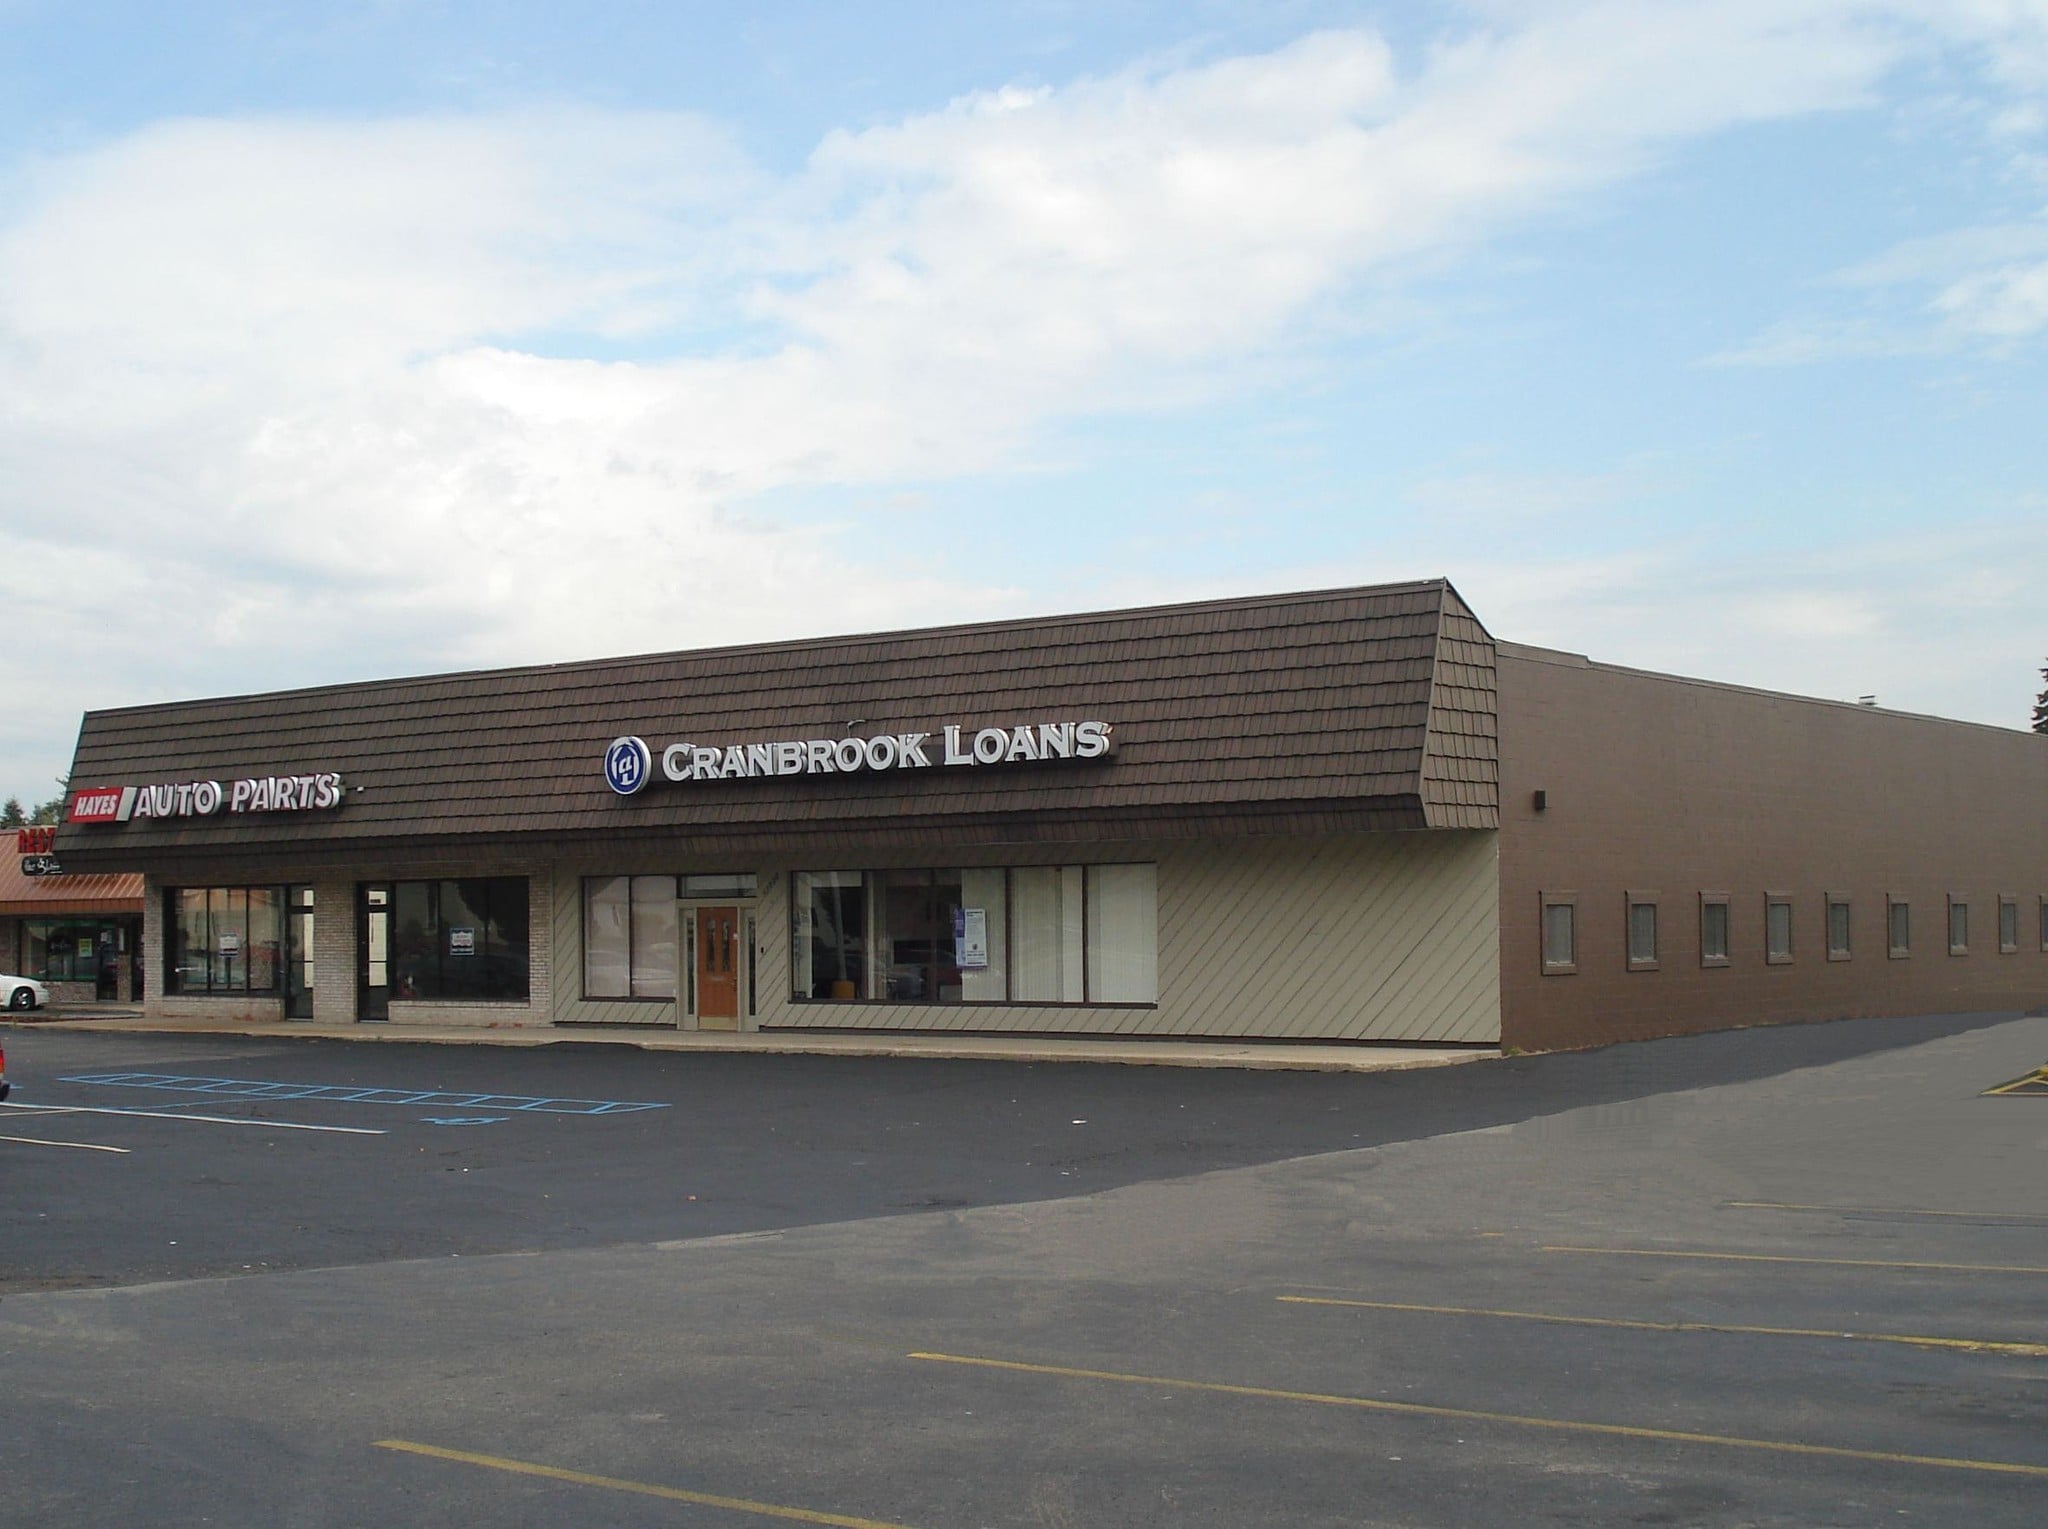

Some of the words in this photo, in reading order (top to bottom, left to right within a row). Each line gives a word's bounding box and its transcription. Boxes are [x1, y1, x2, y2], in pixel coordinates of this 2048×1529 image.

[663, 733, 931, 782] CRANBROOK
[944, 721, 1112, 766] LOANS
[74, 794, 118, 817] HAYES
[133, 781, 221, 819] AUTO
[230, 773, 341, 813] PARTS
